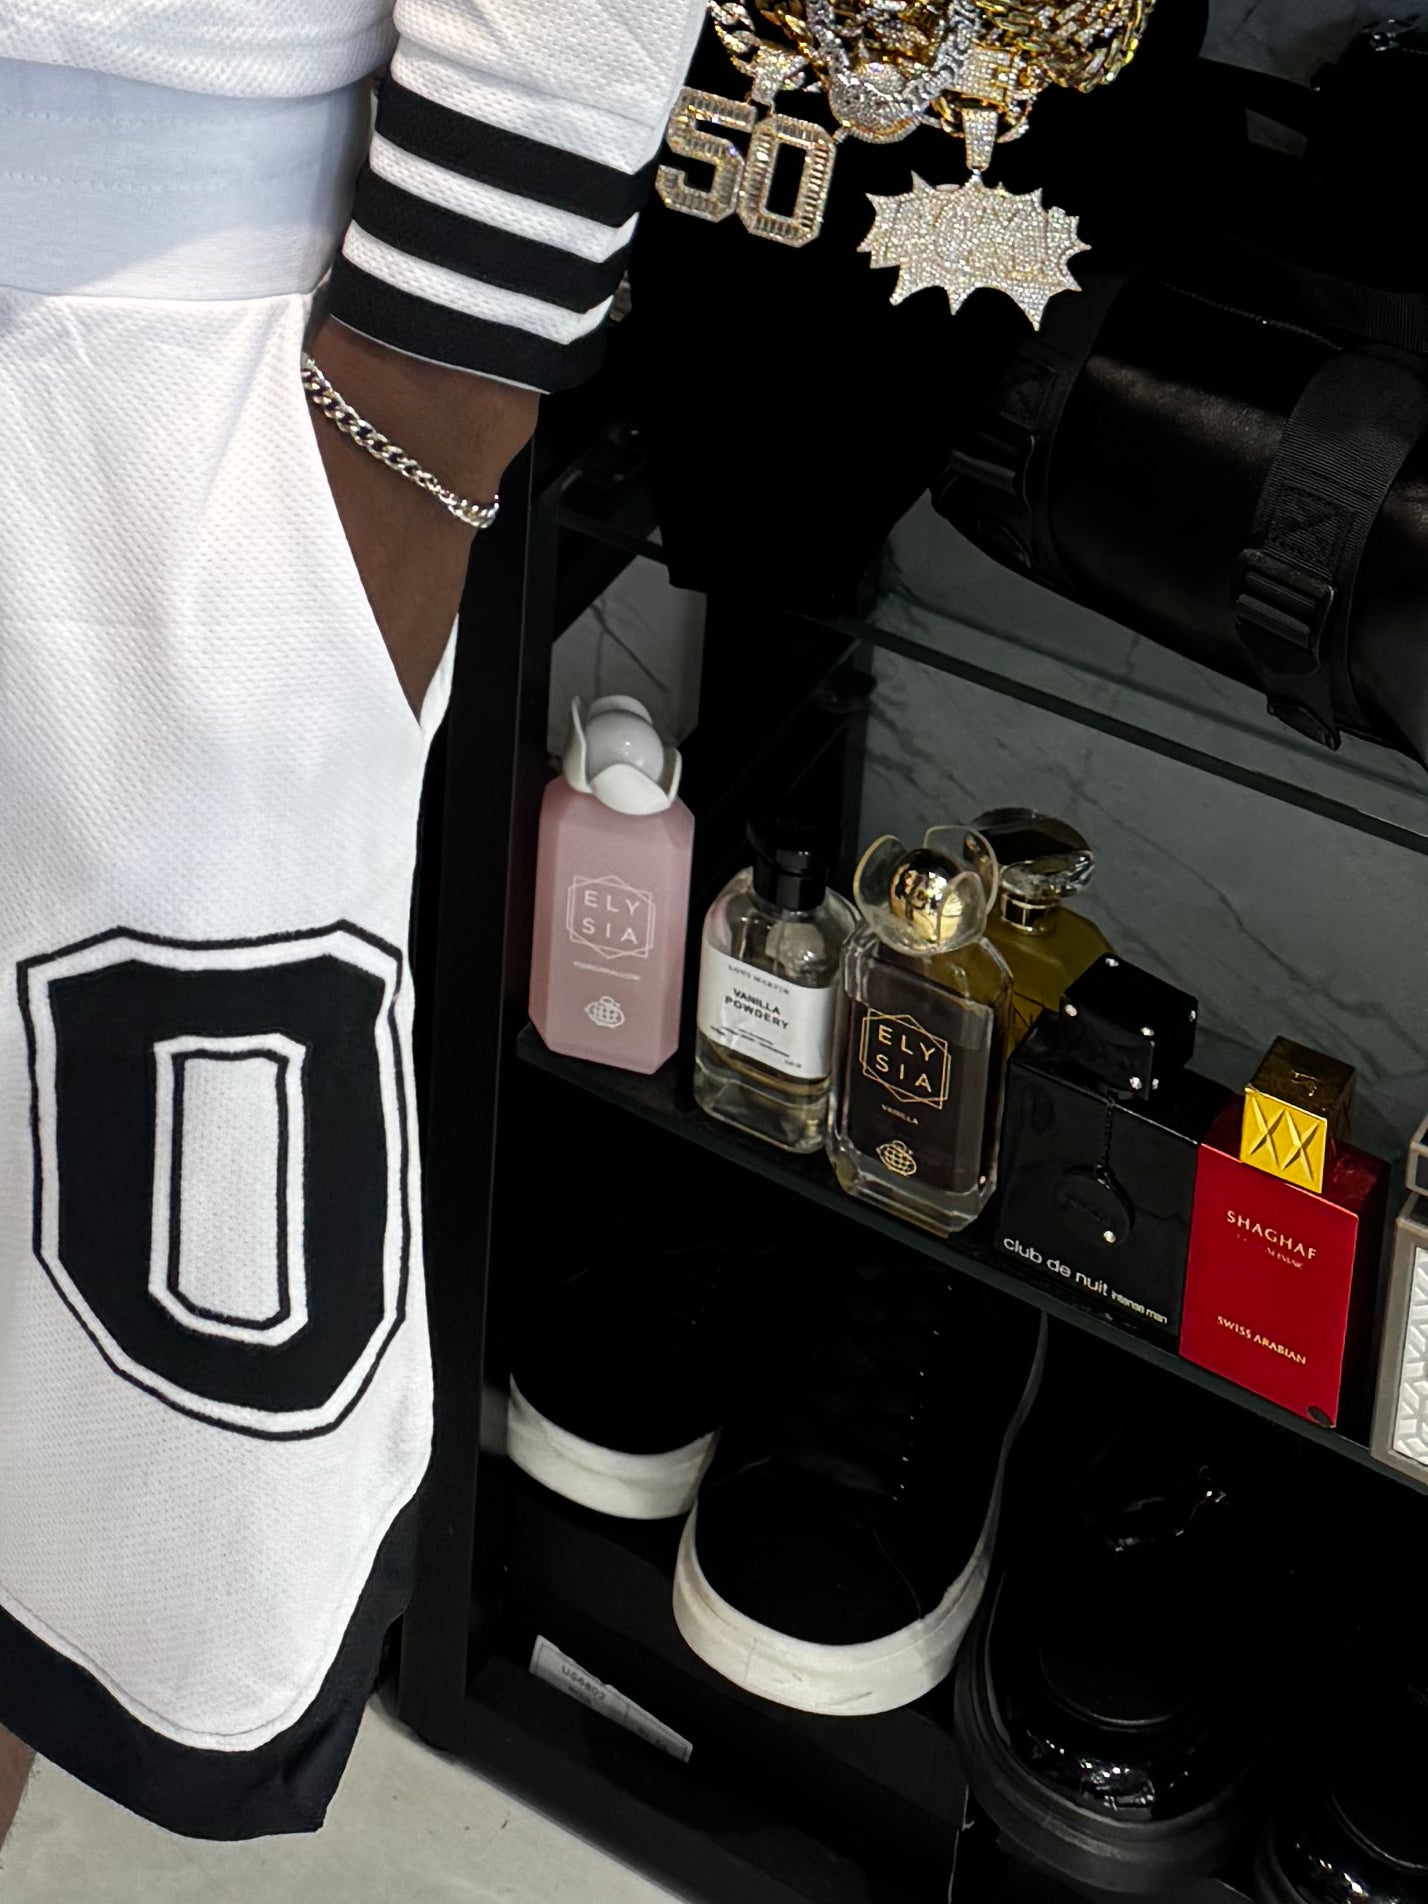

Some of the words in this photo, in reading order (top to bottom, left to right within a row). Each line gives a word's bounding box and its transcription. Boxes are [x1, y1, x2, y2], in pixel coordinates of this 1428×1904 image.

[654, 85, 838, 249] 50
[583, 889, 640, 916] ELY
[581, 917, 639, 945] SIA
[724, 994, 789, 1030] POWDERY
[732, 987, 782, 1015] VANILLA
[878, 1024, 936, 1062] ELY
[875, 1053, 933, 1094] SIA
[1226, 1209, 1318, 1260] SHAGHAF
[1003, 1237, 1043, 1264] club
[1046, 1258, 1072, 1278] de
[1075, 1271, 1108, 1297] nuit
[1217, 1315, 1252, 1340] SWISS
[1253, 1334, 1307, 1365] ARABIAN
